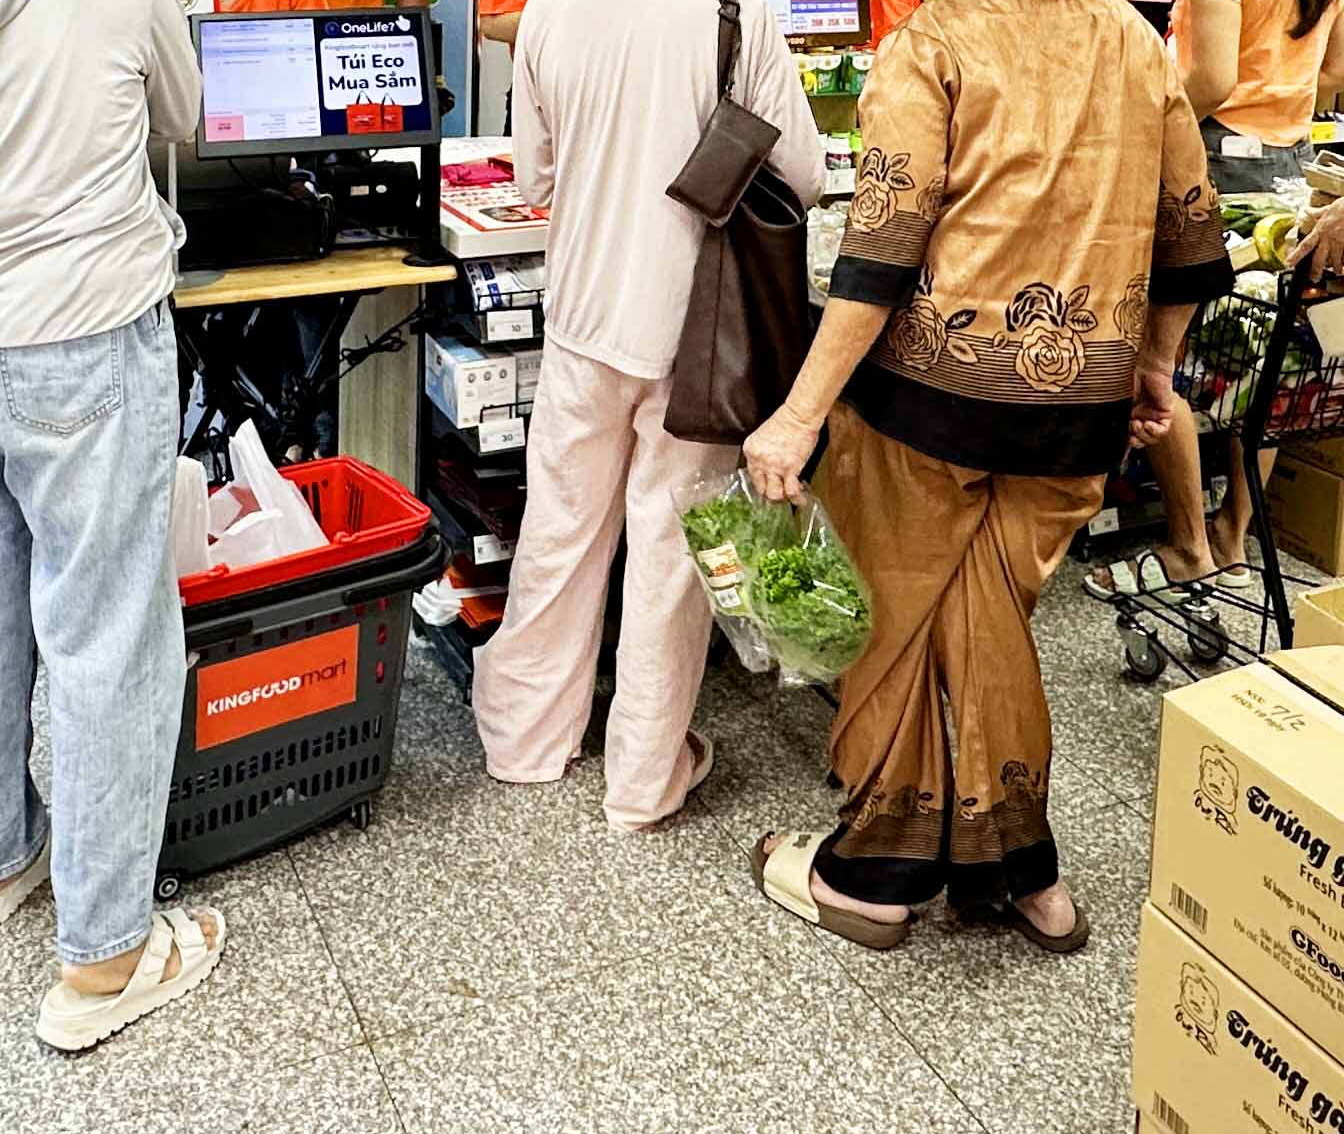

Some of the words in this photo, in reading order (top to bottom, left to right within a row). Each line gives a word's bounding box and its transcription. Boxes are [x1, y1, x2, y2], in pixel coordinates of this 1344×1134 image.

[341, 22, 395, 34] OneLife?
[337, 54, 366, 69] Túi
[371, 54, 404, 68] Eco
[329, 75, 369, 90] Mua
[375, 71, 417, 88] Sắm
[206, 658, 347, 715] KINGFOODmart
[1246, 785, 1331, 869] Trứng
[1299, 864, 1337, 901] Fresh
[1227, 1009, 1309, 1102] Trứng
